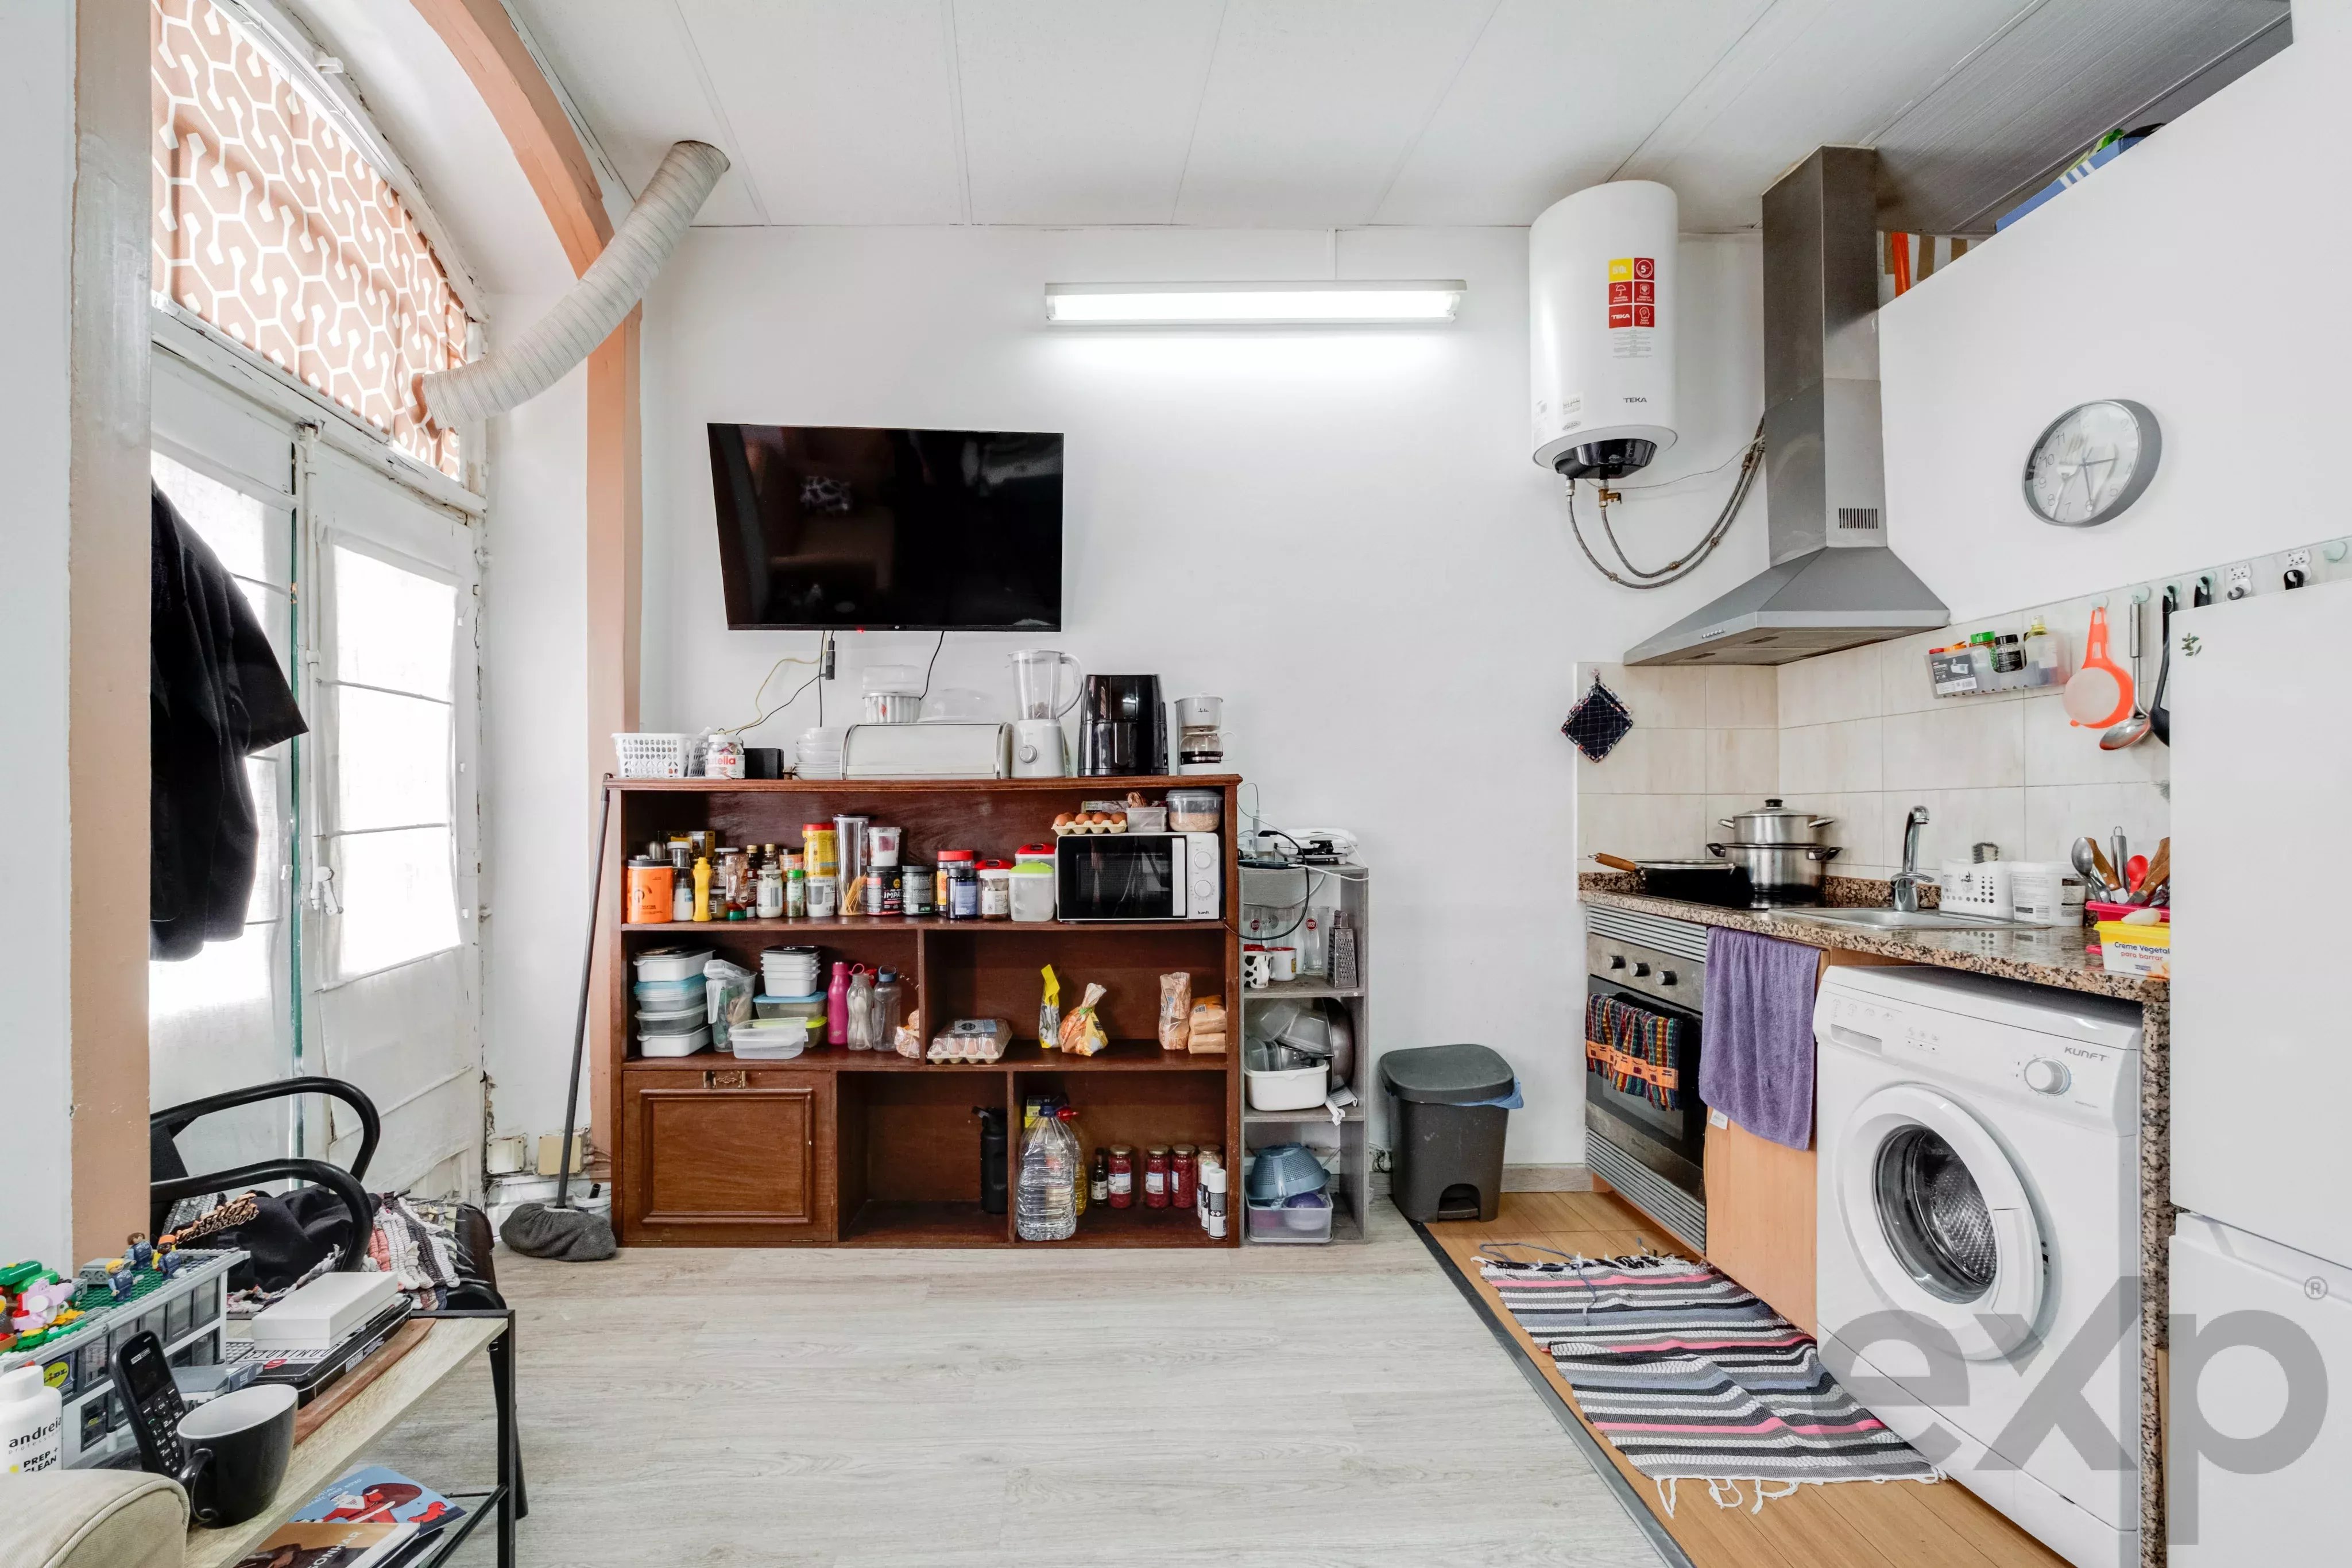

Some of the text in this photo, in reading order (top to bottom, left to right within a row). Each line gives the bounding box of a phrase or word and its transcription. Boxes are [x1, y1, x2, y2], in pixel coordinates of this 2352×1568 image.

[2056, 432, 2065, 446] 11
[2042, 454, 2055, 468] 10
[2039, 477, 2047, 489] 9
[2048, 494, 2055, 506] 8
[2114, 942, 2170, 954] Creme Vegetal
[2139, 953, 2163, 961] barrar
[2064, 1047, 2107, 1062] KUNFT
[9, 1416, 61, 1447] andreia
[24, 1451, 51, 1468] PREP
